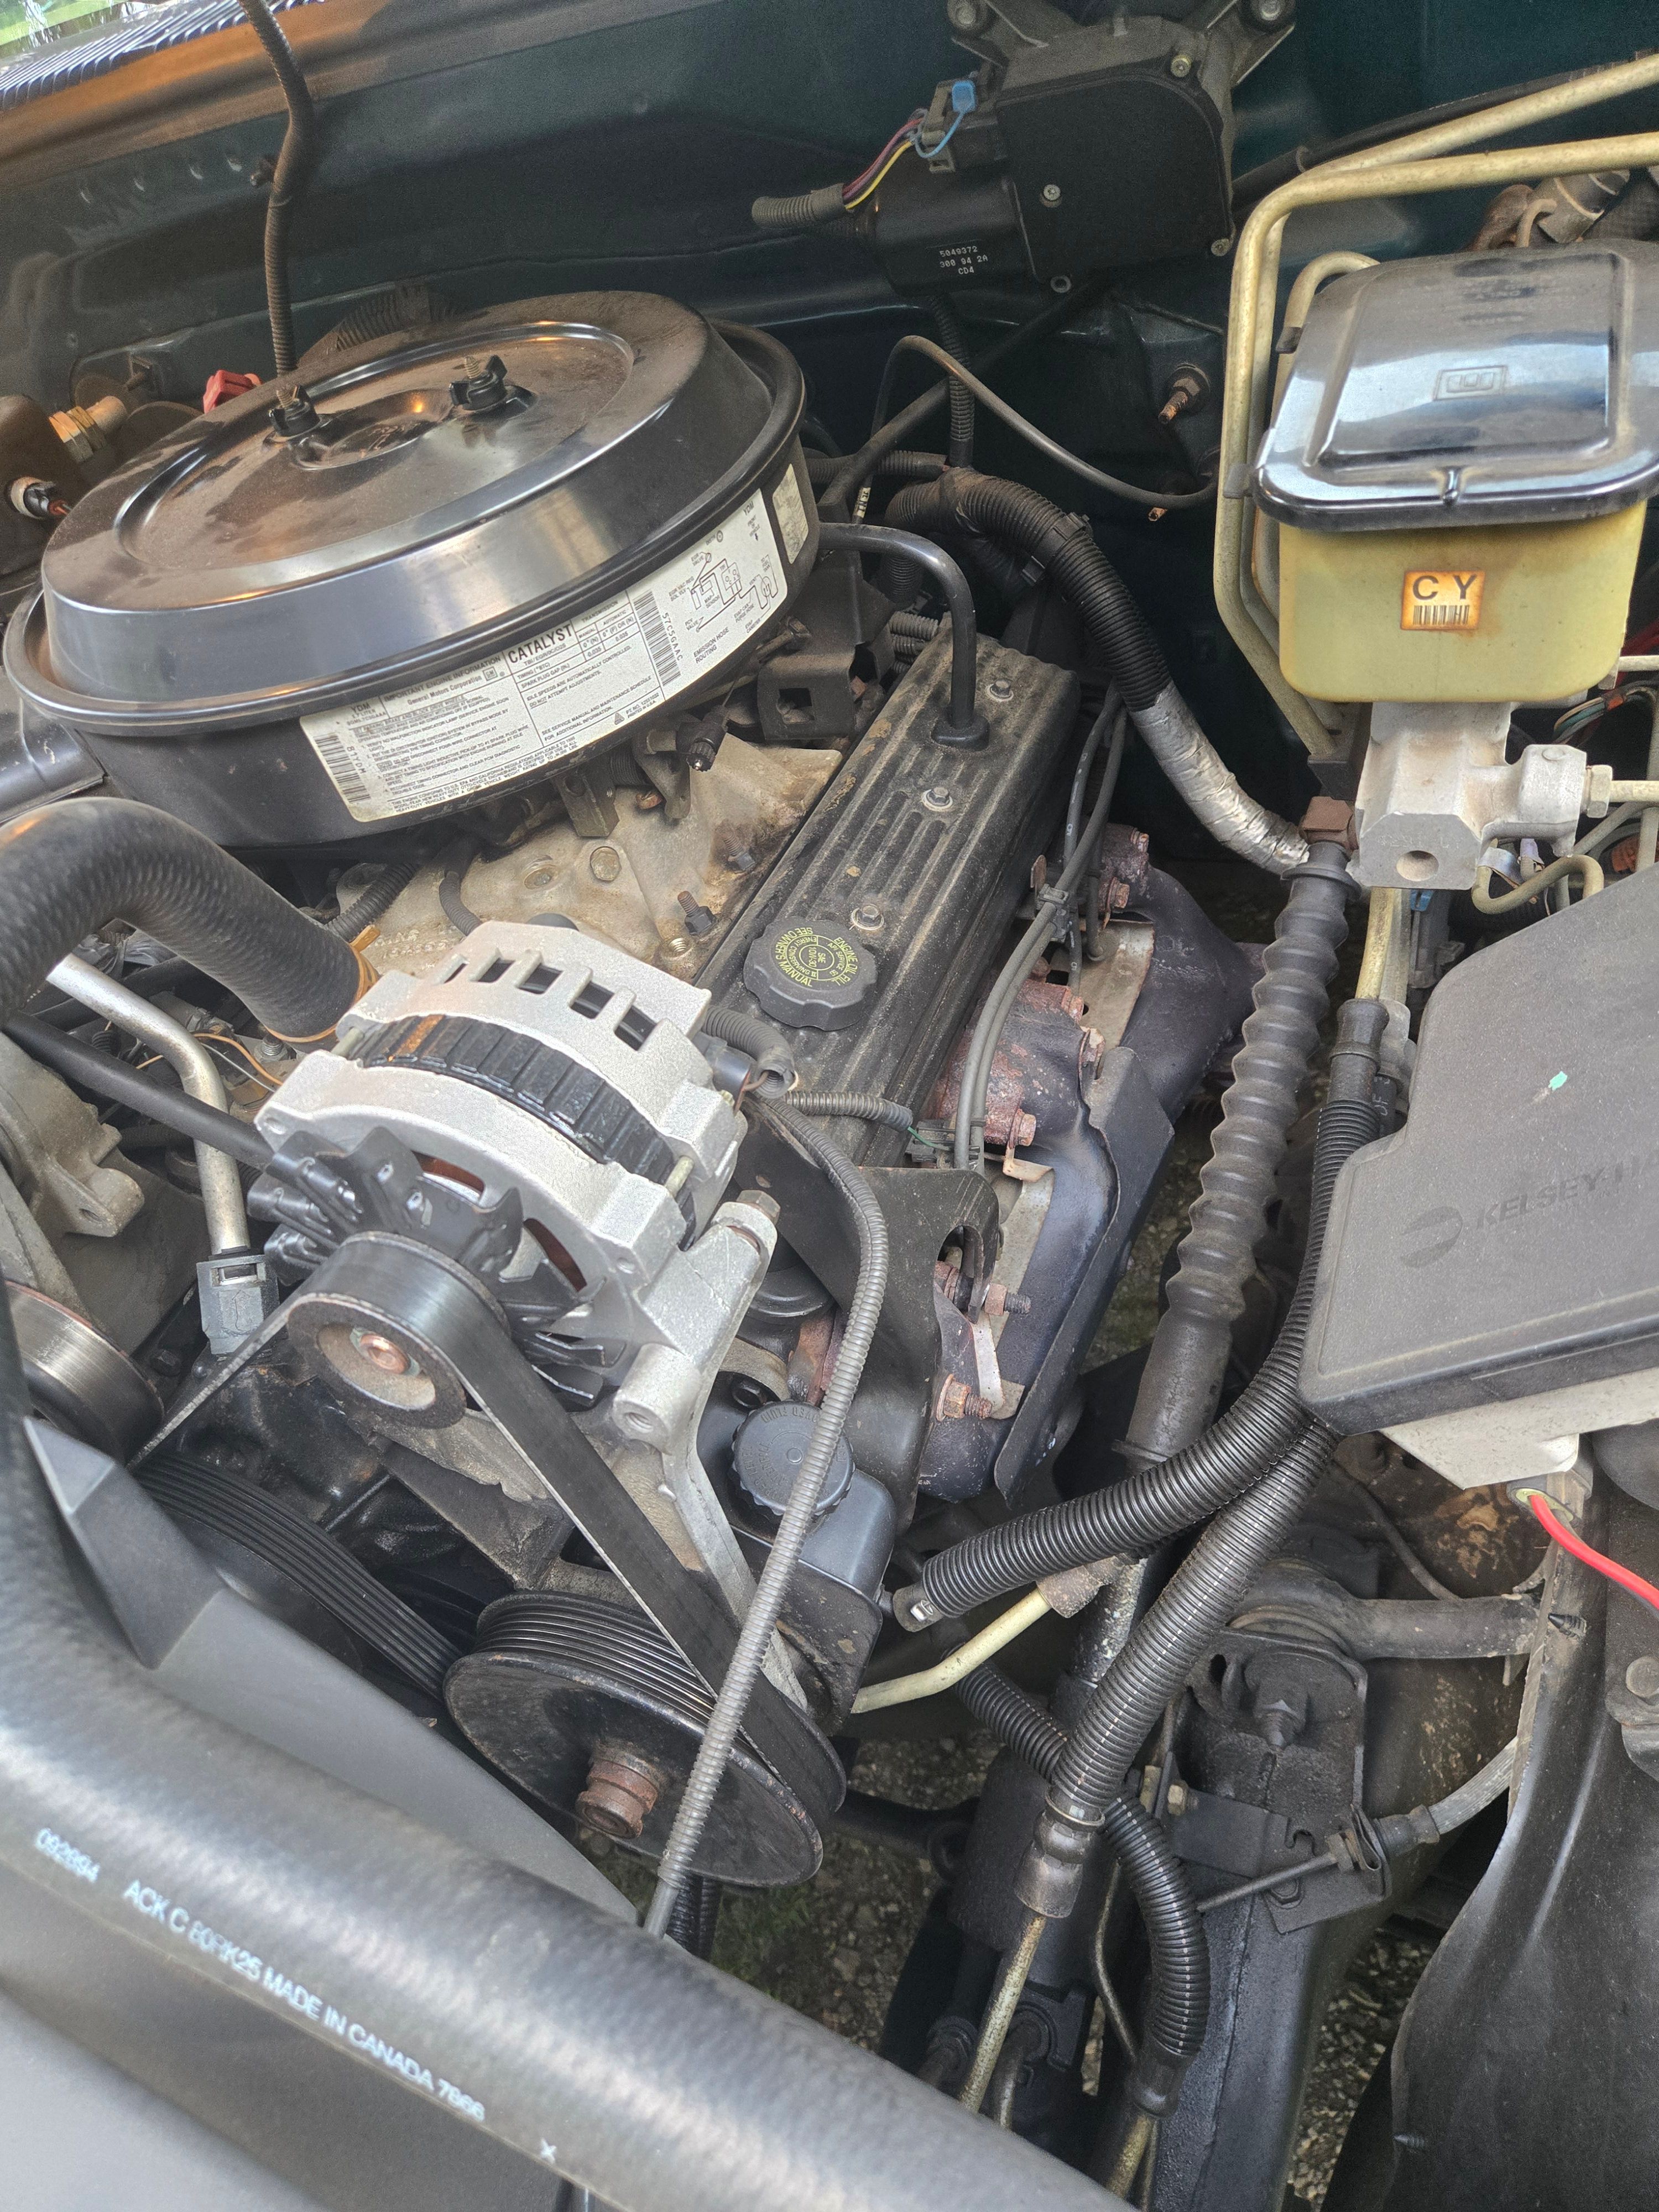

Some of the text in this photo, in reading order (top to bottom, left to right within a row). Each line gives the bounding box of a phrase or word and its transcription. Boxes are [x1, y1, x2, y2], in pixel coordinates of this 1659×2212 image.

[958, 266, 974, 274] CD4
[743, 501, 755, 516] YDM
[578, 609, 627, 638] MANUAL AUTOMATIC
[581, 600, 619, 623] TRANSMISSION
[507, 622, 574, 665] CATALYST
[517, 669, 534, 680] TIMING
[589, 635, 599, 644] (N)
[617, 620, 626, 629] OR
[625, 616, 634, 625] (N)
[662, 612, 684, 661] 57C5GAAC
[693, 625, 729, 659] EMISSION HOSE
[520, 677, 537, 688] SPARK
[537, 672, 550, 681] PLUG
[549, 666, 561, 675] GAP
[587, 646, 602, 657] 0.035
[614, 631, 629, 641] 0.035
[695, 642, 717, 665] ROUTING
[383, 656, 502, 703] IMPORTANT ENGINE INFORMATION
[406, 675, 483, 706] General Motors Corporation
[526, 693, 538, 701] IDLE
[538, 684, 556, 696] SPEEDS
[566, 661, 602, 682] AUTOMATICALLY
[547, 686, 568, 699] ATTEMPT
[350, 701, 371, 713] YDM
[359, 707, 375, 717] LITER
[551, 719, 571, 731] SERVICE
[571, 709, 590, 721] MANUAL
[599, 688, 630, 707] MAINTENANCE
[628, 675, 653, 691] SCHEDULE
[390, 728, 421, 742] MALFUNCTION
[421, 721, 445, 732] INDICATOR
[478, 702, 495, 711] ENGINE
[447, 725, 465, 734] SYSTEM
[470, 716, 489, 726] BYPASS
[555, 721, 582, 736] ADDITIONAL
[374, 747, 409, 763] DISCONNECTING
[419, 740, 434, 749] TIMING
[383, 768, 403, 779] CONNECT
[436, 751, 459, 762] INDUCTIVE
[460, 745, 477, 754] PICK-UP
[489, 734, 505, 743] SPARK
[410, 747, 438, 759] DISCONNECT
[439, 738, 463, 750] FOUR-WIRE
[463, 728, 491, 741] CONNECTOR
[426, 756, 458, 770] SPECIFICATION
[469, 747, 486, 755] ENGINE
[486, 739, 507, 749] RUNNING
[390, 780, 416, 792] RECONNECT
[431, 767, 458, 779] CONNECTOR
[468, 758, 484, 767] CLEAR
[493, 744, 520, 757] DIAGNOSTIC
[775, 927, 813, 987] SEE OWNERS MANUAL
[794, 937, 817, 947] ENERGY
[808, 947, 817, 967] 10W-30
[817, 952, 826, 963] SAE
[827, 942, 839, 951] API
[836, 951, 844, 971] SERVICE
[788, 946, 811, 974] CONSERVING
[831, 937, 858, 986] ENGINE OIL FILL
[169, 1906, 190, 1933] C
[263, 1966, 323, 2021] MADE
[324, 2005, 348, 2036] IN
[348, 2023, 435, 2091] CANADA
